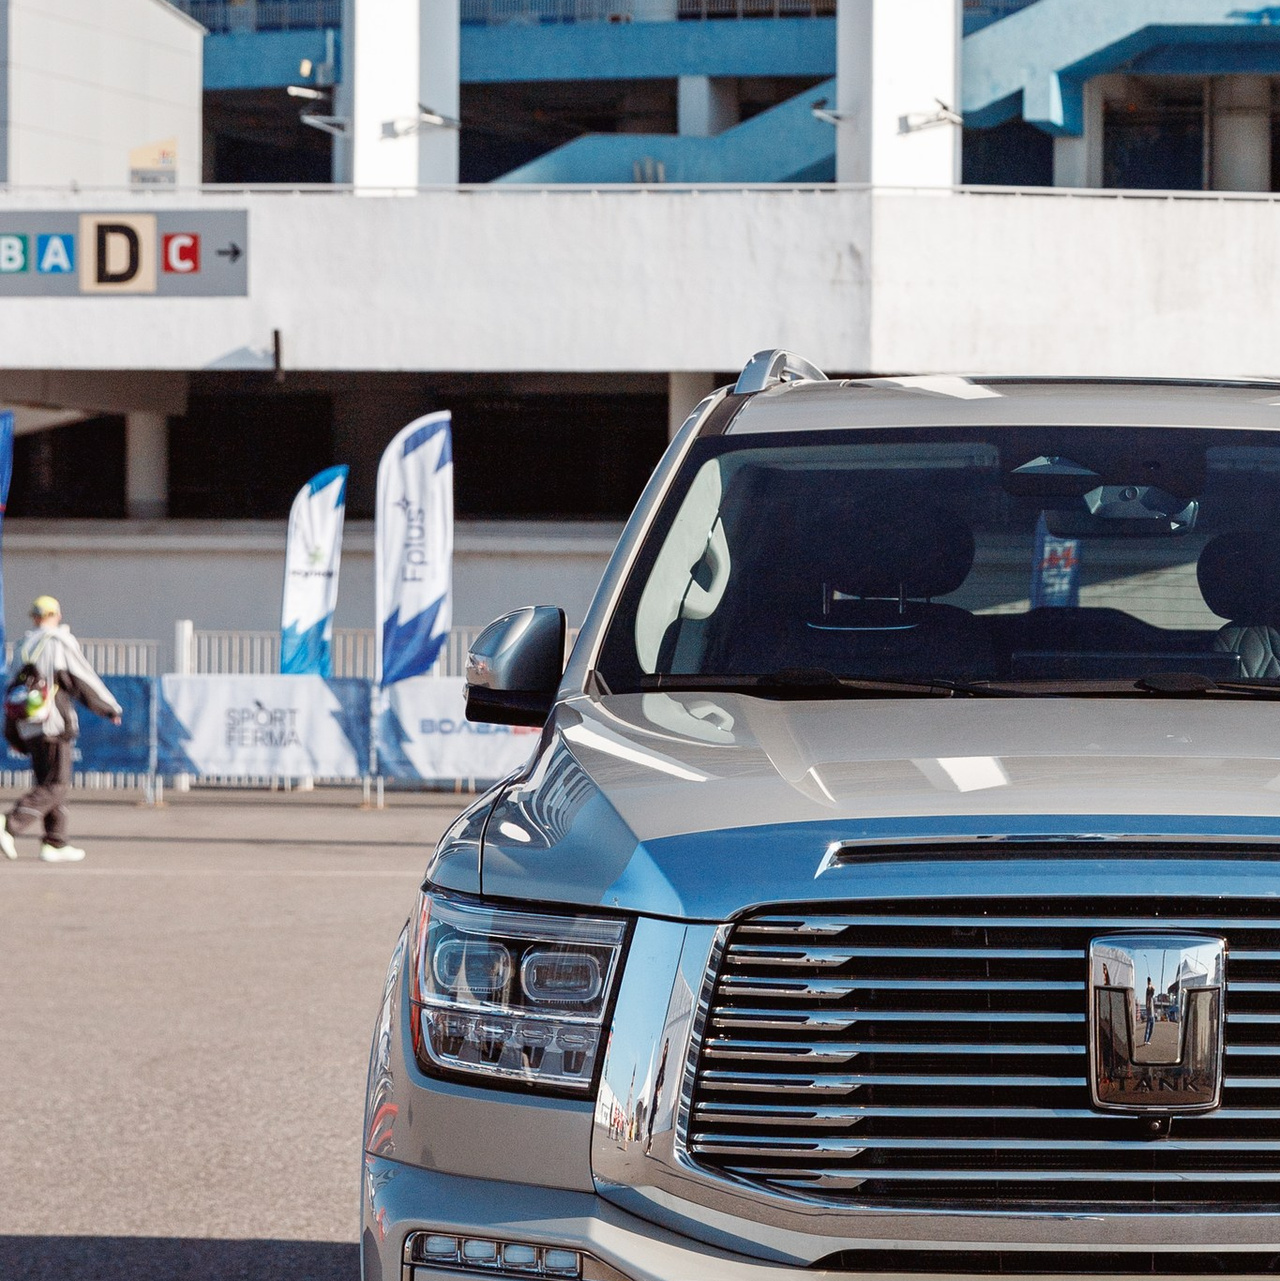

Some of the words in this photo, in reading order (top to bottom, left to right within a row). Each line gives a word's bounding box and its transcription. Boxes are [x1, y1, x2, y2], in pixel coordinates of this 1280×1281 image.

[0, 236, 25, 272] B
[41, 236, 72, 272] A
[96, 225, 140, 284] D
[168, 235, 195, 271] C
[1113, 1075, 1200, 1092] TANK
